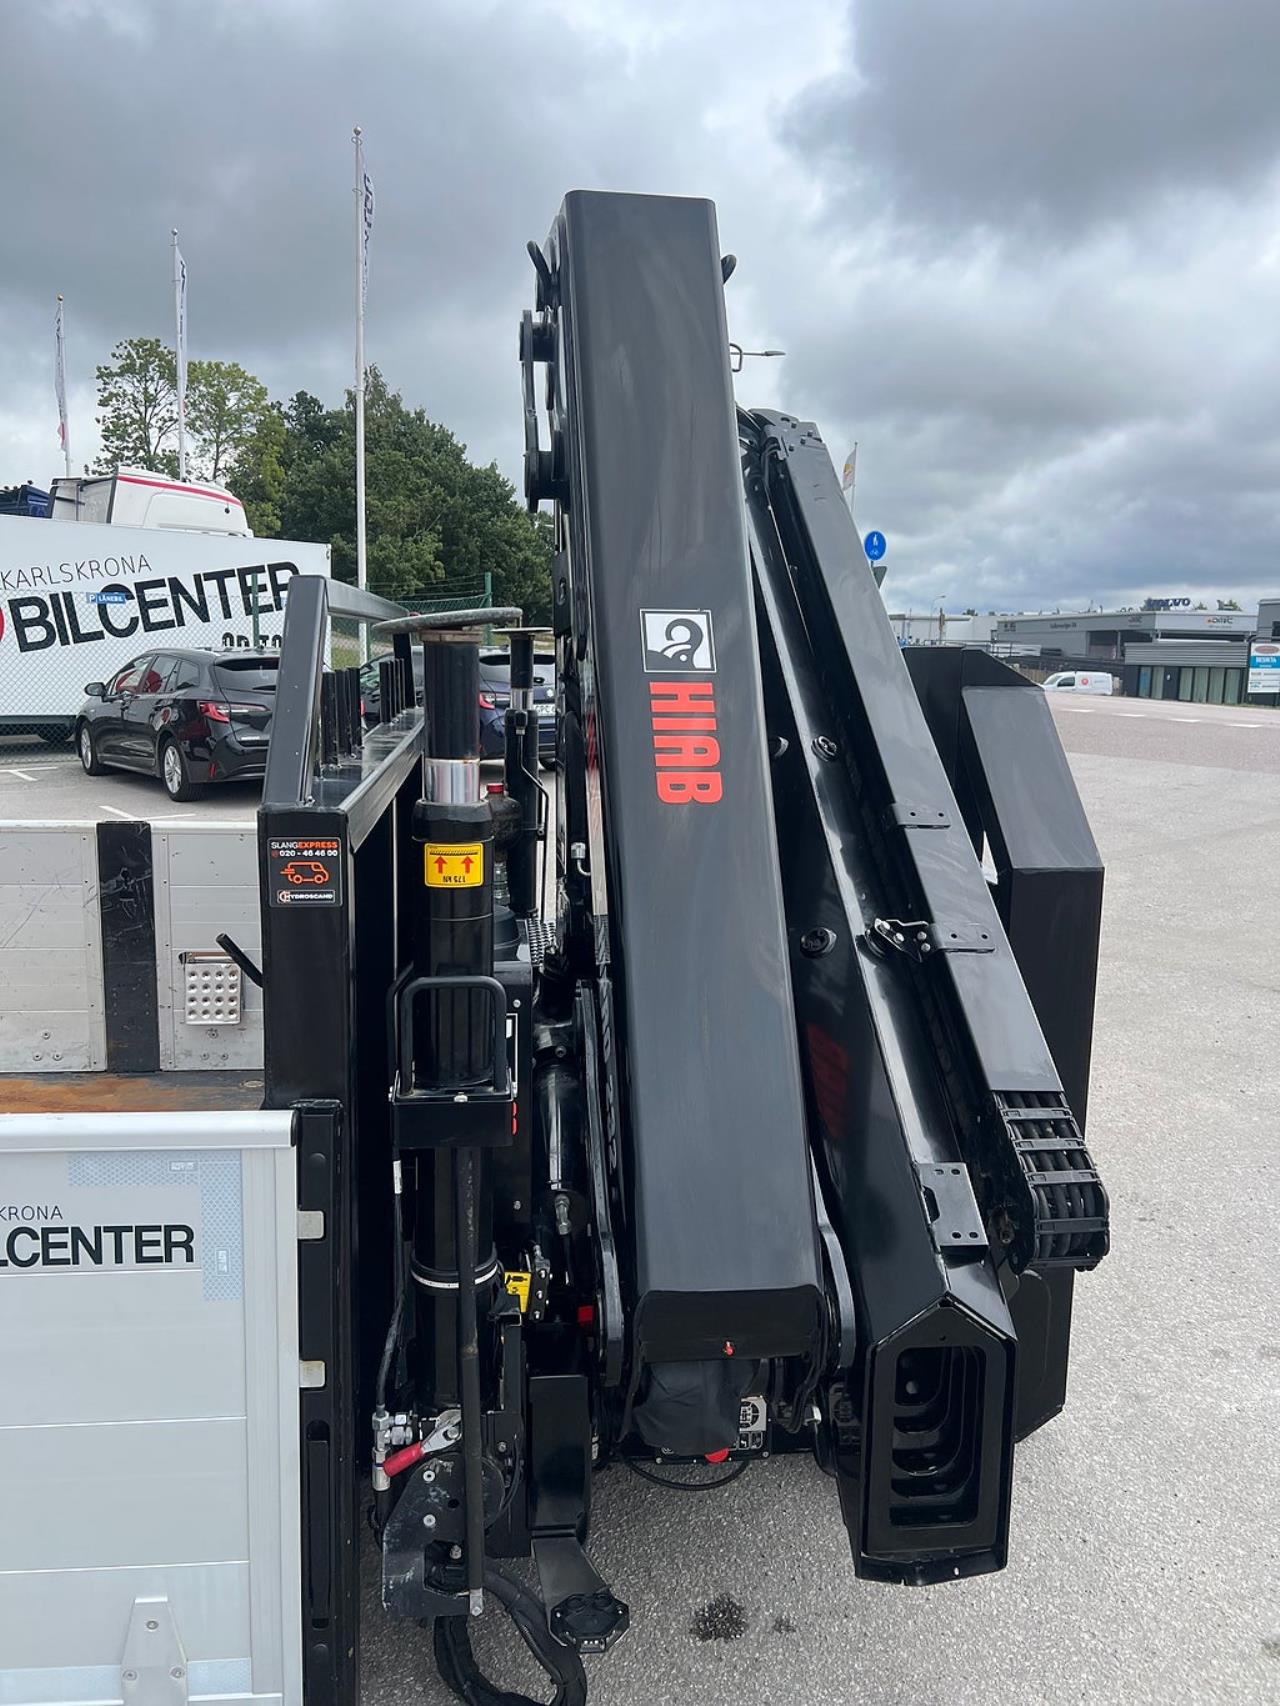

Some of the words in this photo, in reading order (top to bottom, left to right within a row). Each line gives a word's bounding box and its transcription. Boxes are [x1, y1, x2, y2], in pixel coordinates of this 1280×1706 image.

[0, 554, 152, 590] KARLSKRONA
[1147, 598, 1191, 608] VOLVO
[649, 681, 723, 804] HIAB
[271, 841, 338, 850] SLANGEXPRESS
[279, 849, 296, 857] 020
[327, 849, 338, 857] 00
[0, 1224, 195, 1269] CENTER
